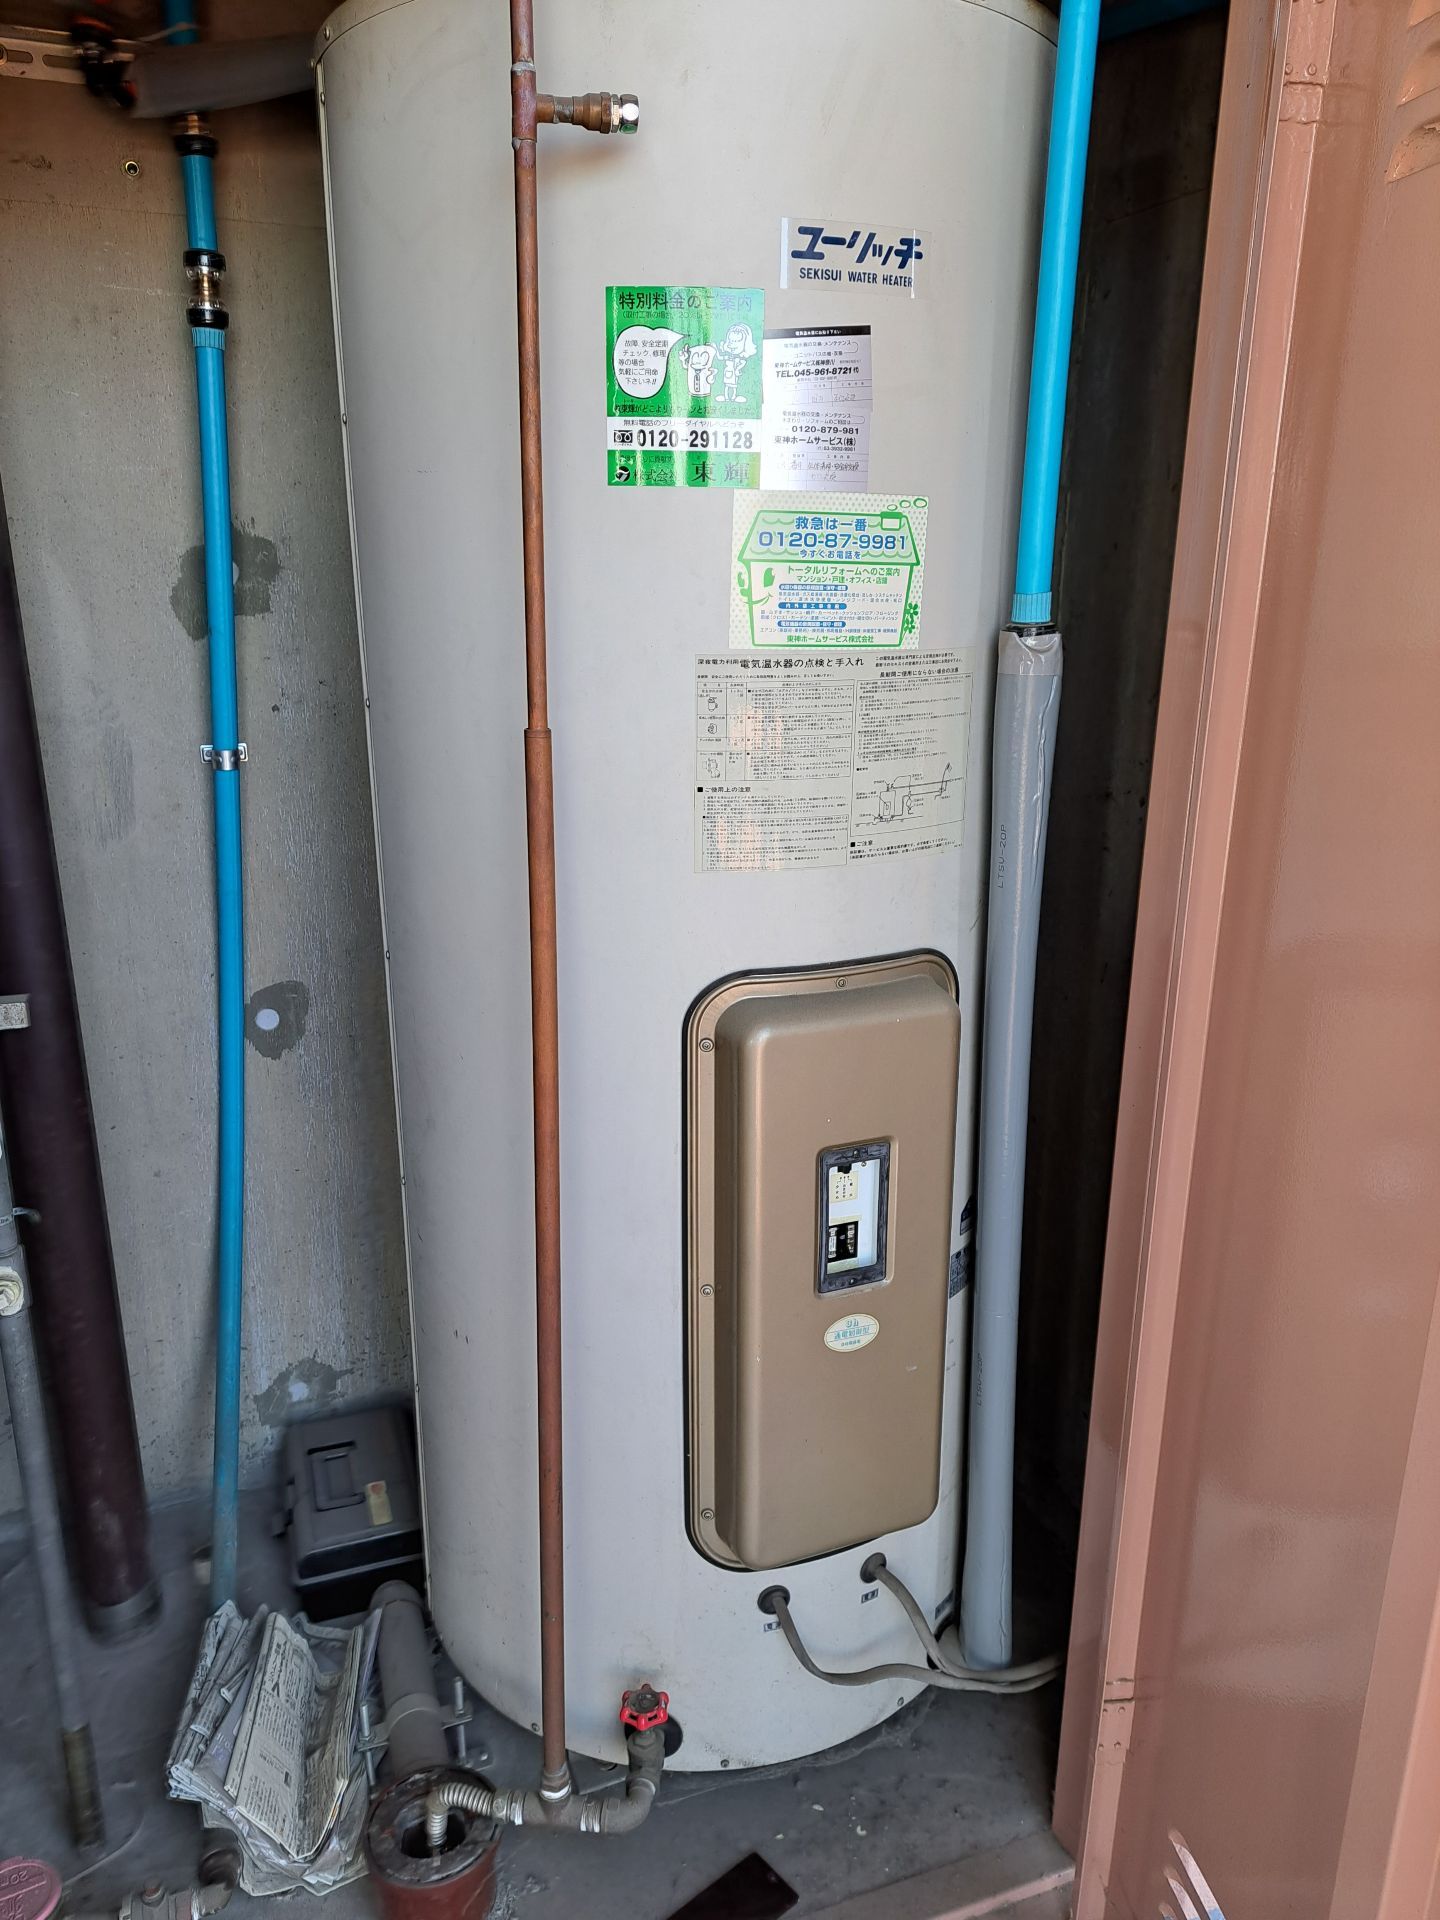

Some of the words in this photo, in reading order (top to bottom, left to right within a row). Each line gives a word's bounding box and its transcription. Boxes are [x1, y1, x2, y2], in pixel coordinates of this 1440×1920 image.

[791, 225, 924, 269] ユーリッチ
[799, 267, 842, 282] SEKISUI
[848, 270, 878, 285] WATER
[882, 274, 913, 288] HEATER
[619, 292, 752, 312] 特別料金のご案内
[792, 425, 859, 435] 0120-879-981
[636, 429, 753, 449] 0120-291128
[795, 516, 867, 532] 救急は一番
[758, 531, 906, 550] 0120-87-9981
[799, 549, 861, 560] 今すぐお電話を
[788, 565, 900, 577] トータルリフォームへのご案内
[740, 657, 865, 669] 電気温水器の点検と手入れ
